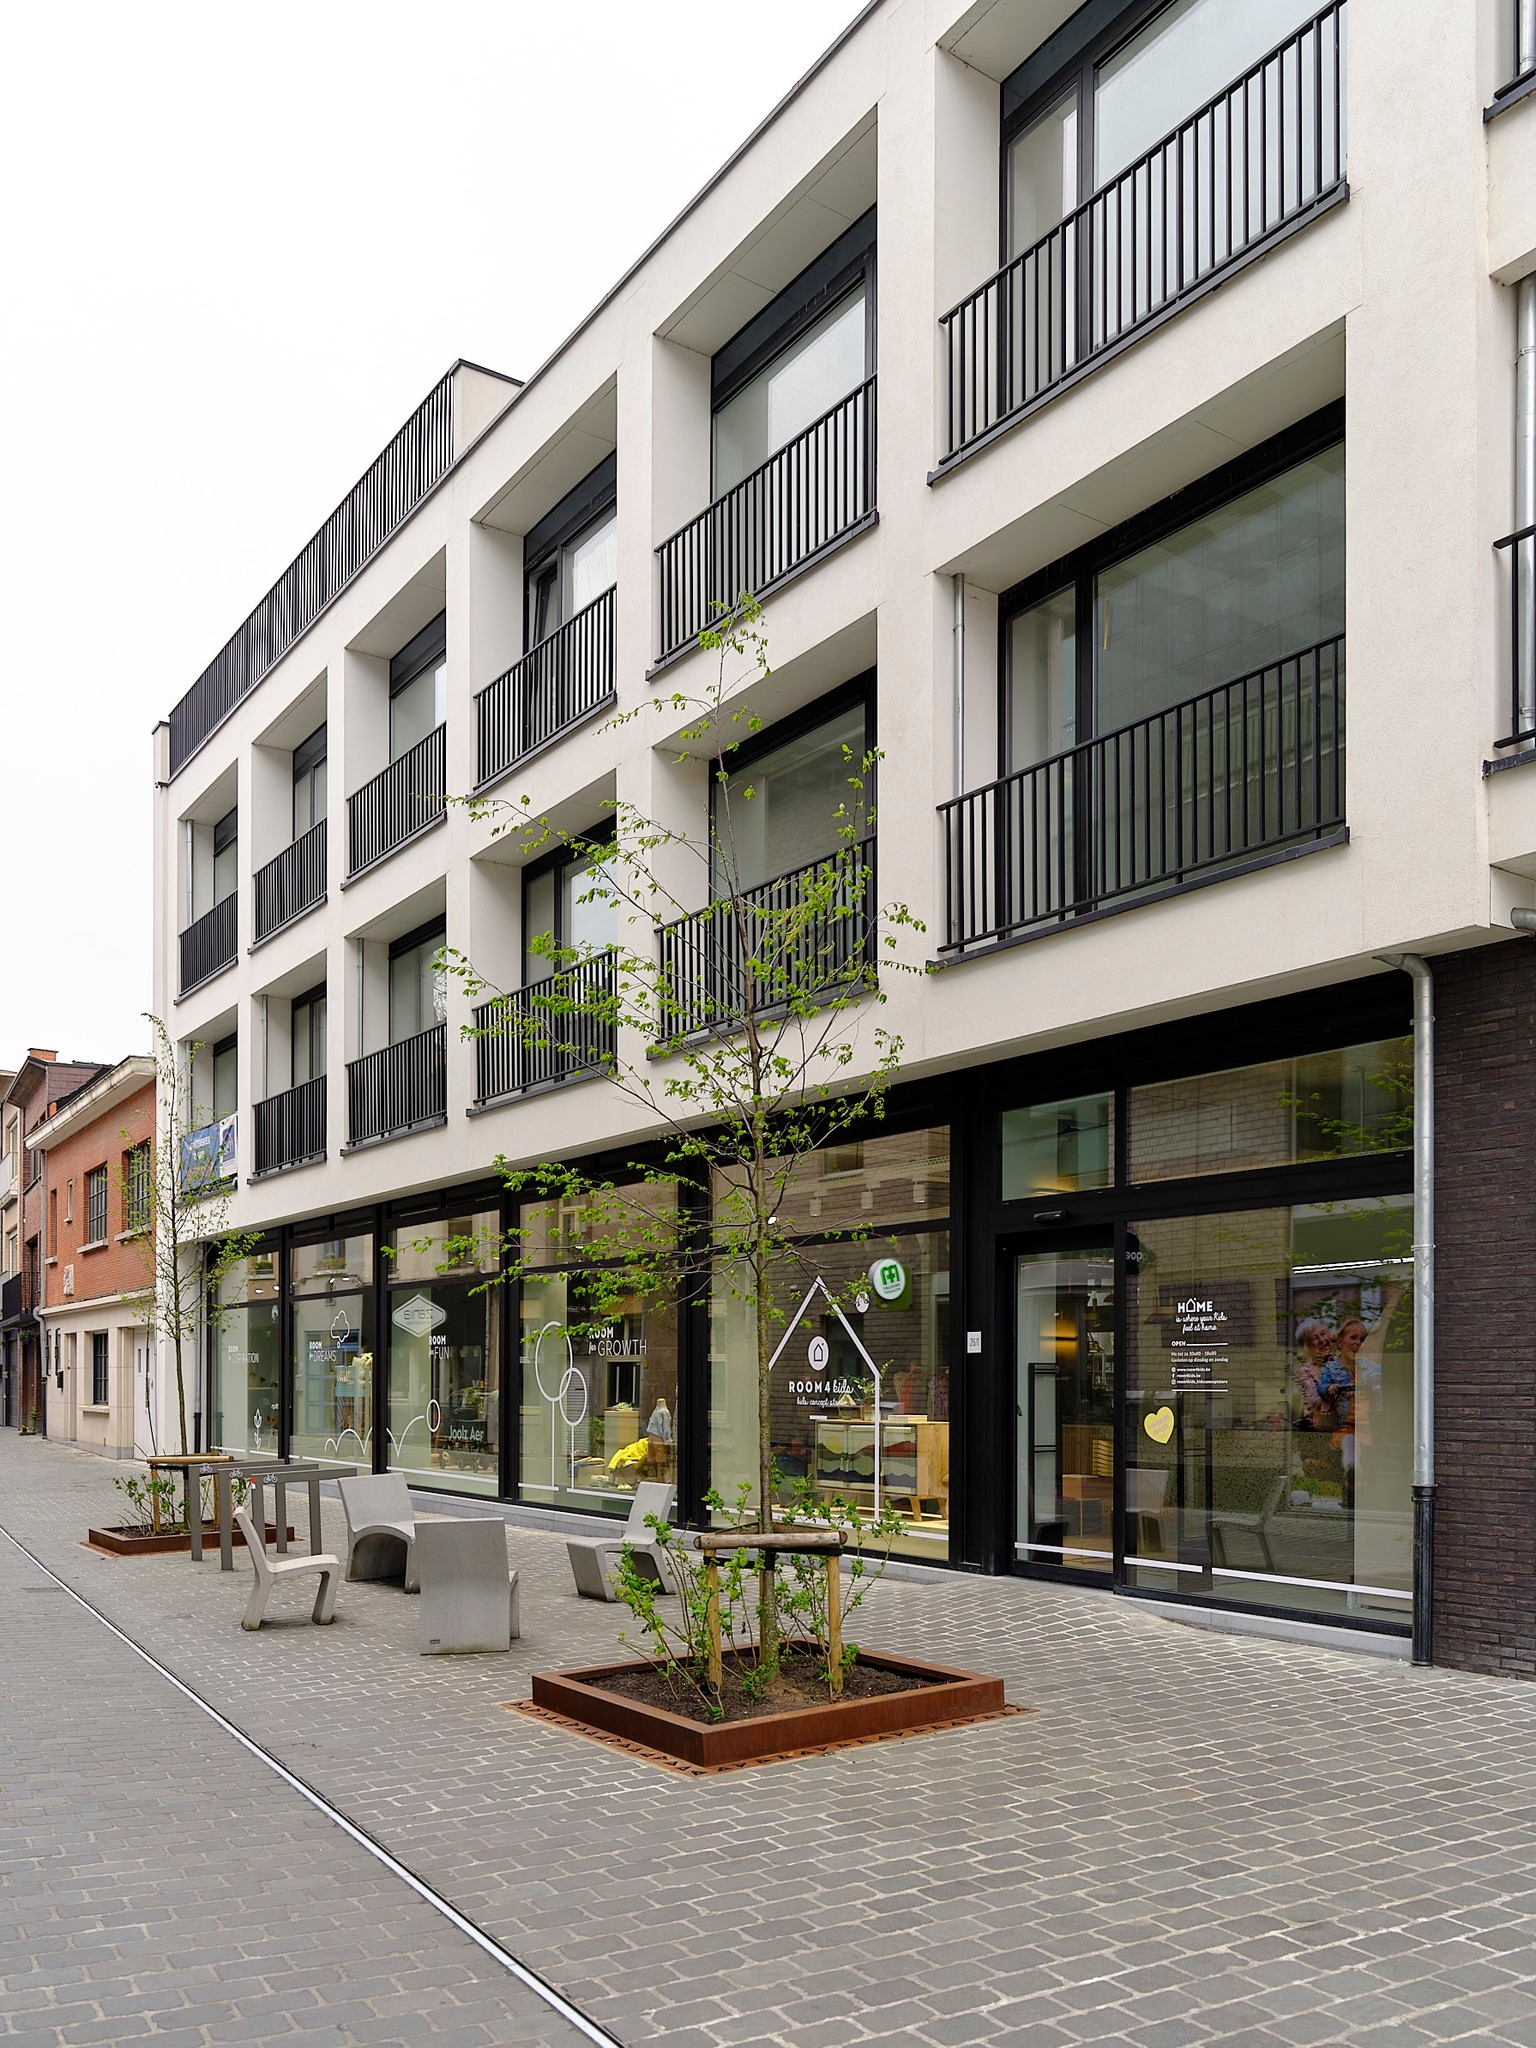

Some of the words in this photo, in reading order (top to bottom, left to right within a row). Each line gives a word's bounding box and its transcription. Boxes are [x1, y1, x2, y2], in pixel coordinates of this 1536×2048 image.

[309, 1340, 323, 1350] ROOM
[428, 1335, 446, 1346] ROOM
[434, 1346, 450, 1360] FUN
[597, 1338, 647, 1357] GROWTH
[313, 1350, 337, 1362] DREAMS
[449, 1424, 468, 1441] Joolz
[469, 1425, 485, 1442] Aer
